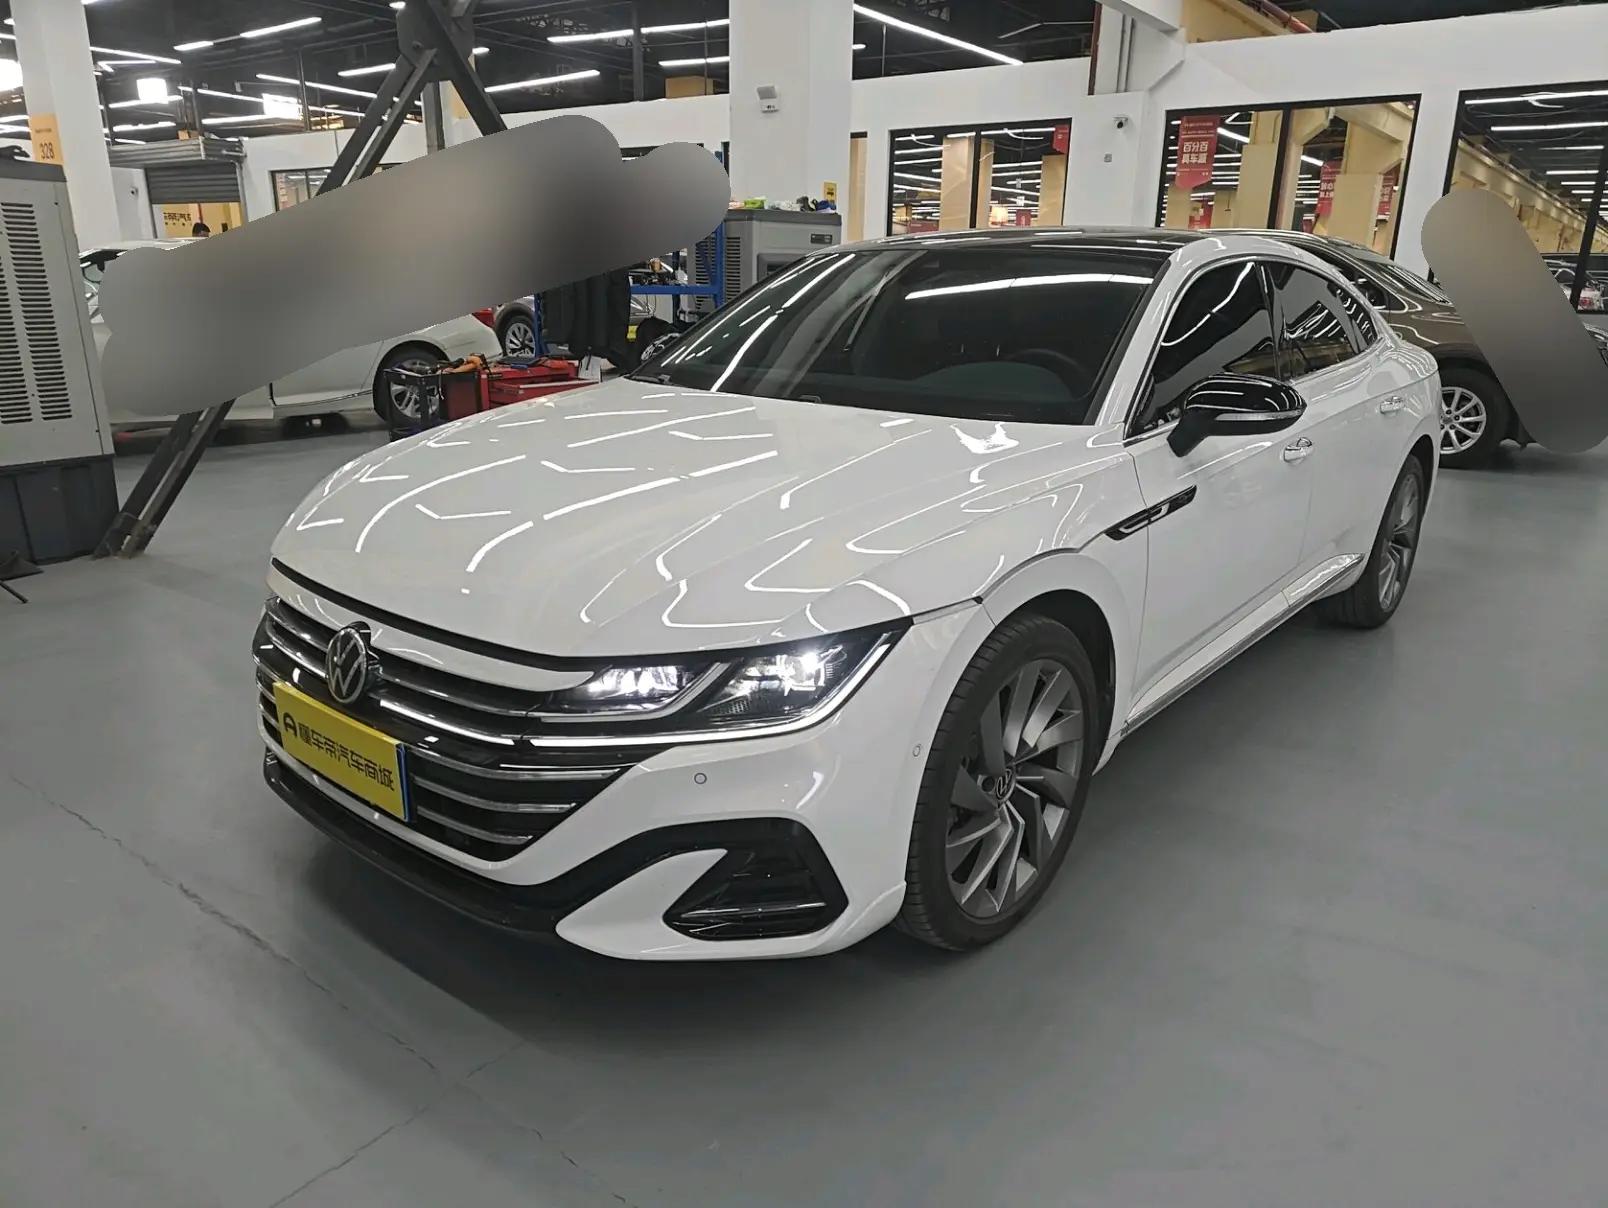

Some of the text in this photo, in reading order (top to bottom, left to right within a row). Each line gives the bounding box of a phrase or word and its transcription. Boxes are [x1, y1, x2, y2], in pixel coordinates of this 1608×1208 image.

[40, 142, 55, 159] 328
[1183, 141, 1209, 153] 百分百
